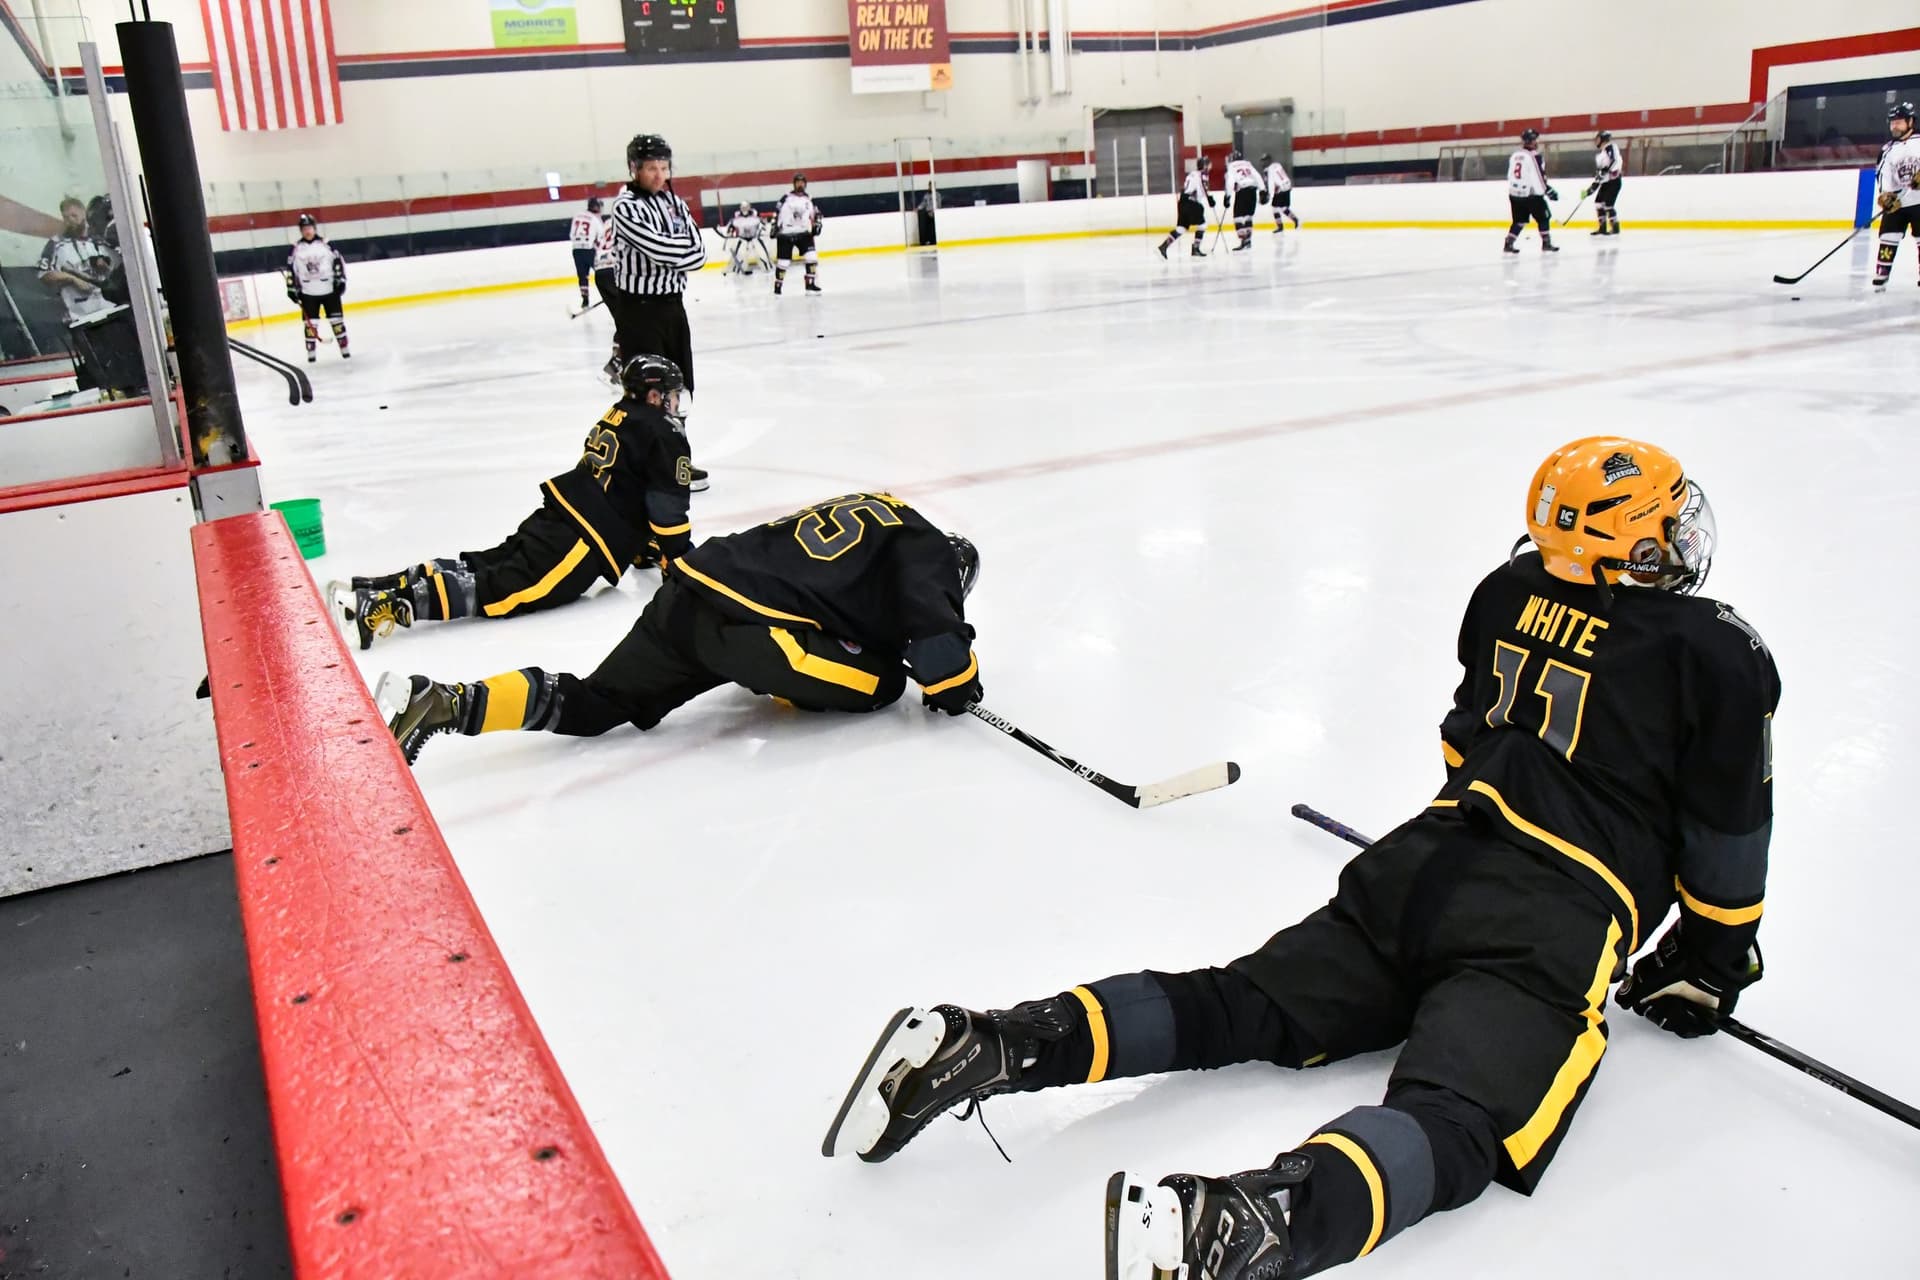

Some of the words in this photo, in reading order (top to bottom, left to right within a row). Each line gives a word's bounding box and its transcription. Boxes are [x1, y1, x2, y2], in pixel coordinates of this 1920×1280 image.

[857, 5, 892, 27] REAL
[895, 4, 929, 26] PAIN
[858, 29, 881, 51] ON
[883, 28, 910, 50] THE
[912, 28, 934, 49] ICE
[676, 456, 691, 485] 6
[1515, 594, 1609, 657] WHITE
[1485, 639, 1591, 763] 11
[931, 1043, 981, 1089] CCM
[1201, 1209, 1235, 1280] CC
